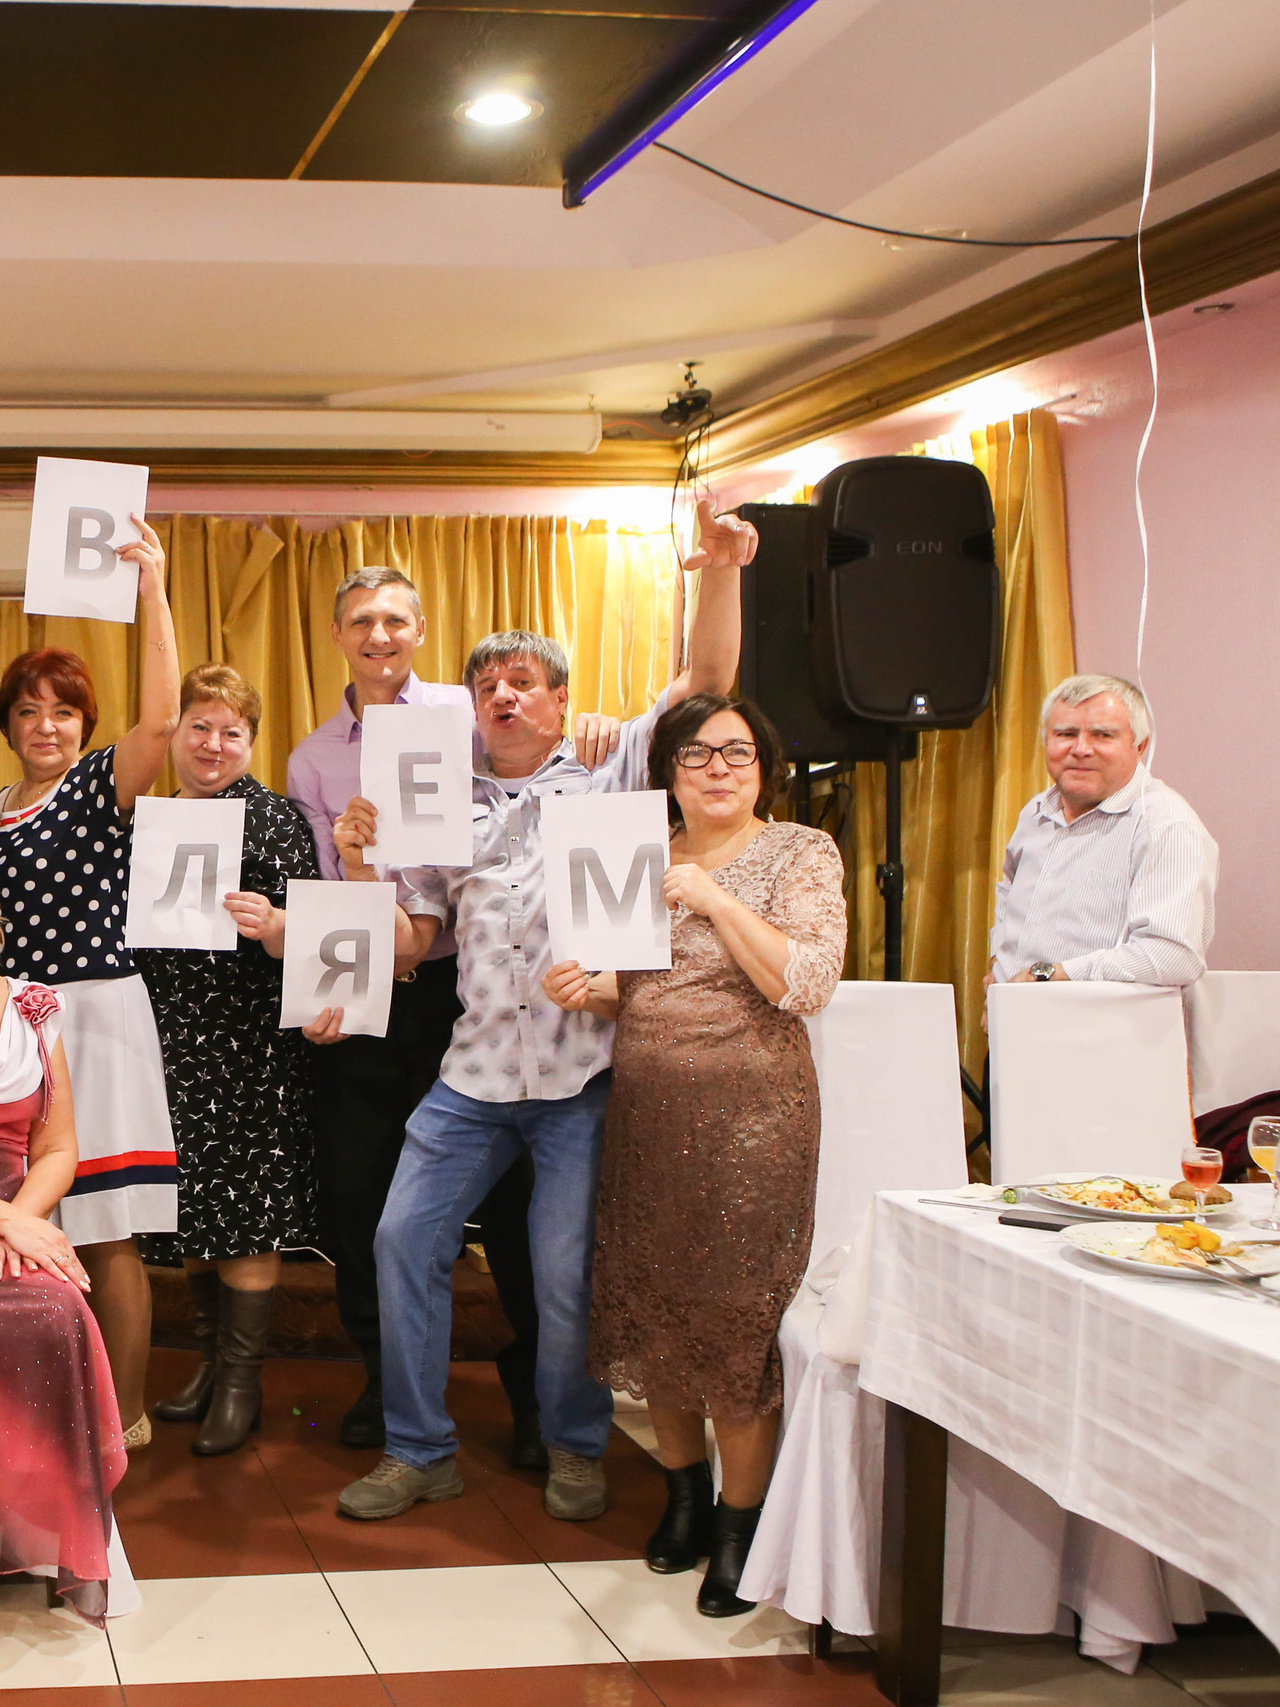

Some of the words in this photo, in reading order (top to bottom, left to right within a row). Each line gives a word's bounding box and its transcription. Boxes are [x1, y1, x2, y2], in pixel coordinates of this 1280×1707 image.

[64, 506, 117, 580] В
[897, 540, 942, 554] EON
[398, 751, 444, 828] Е
[152, 843, 219, 915] Л
[569, 843, 669, 932] М
[313, 929, 371, 1000] Я
